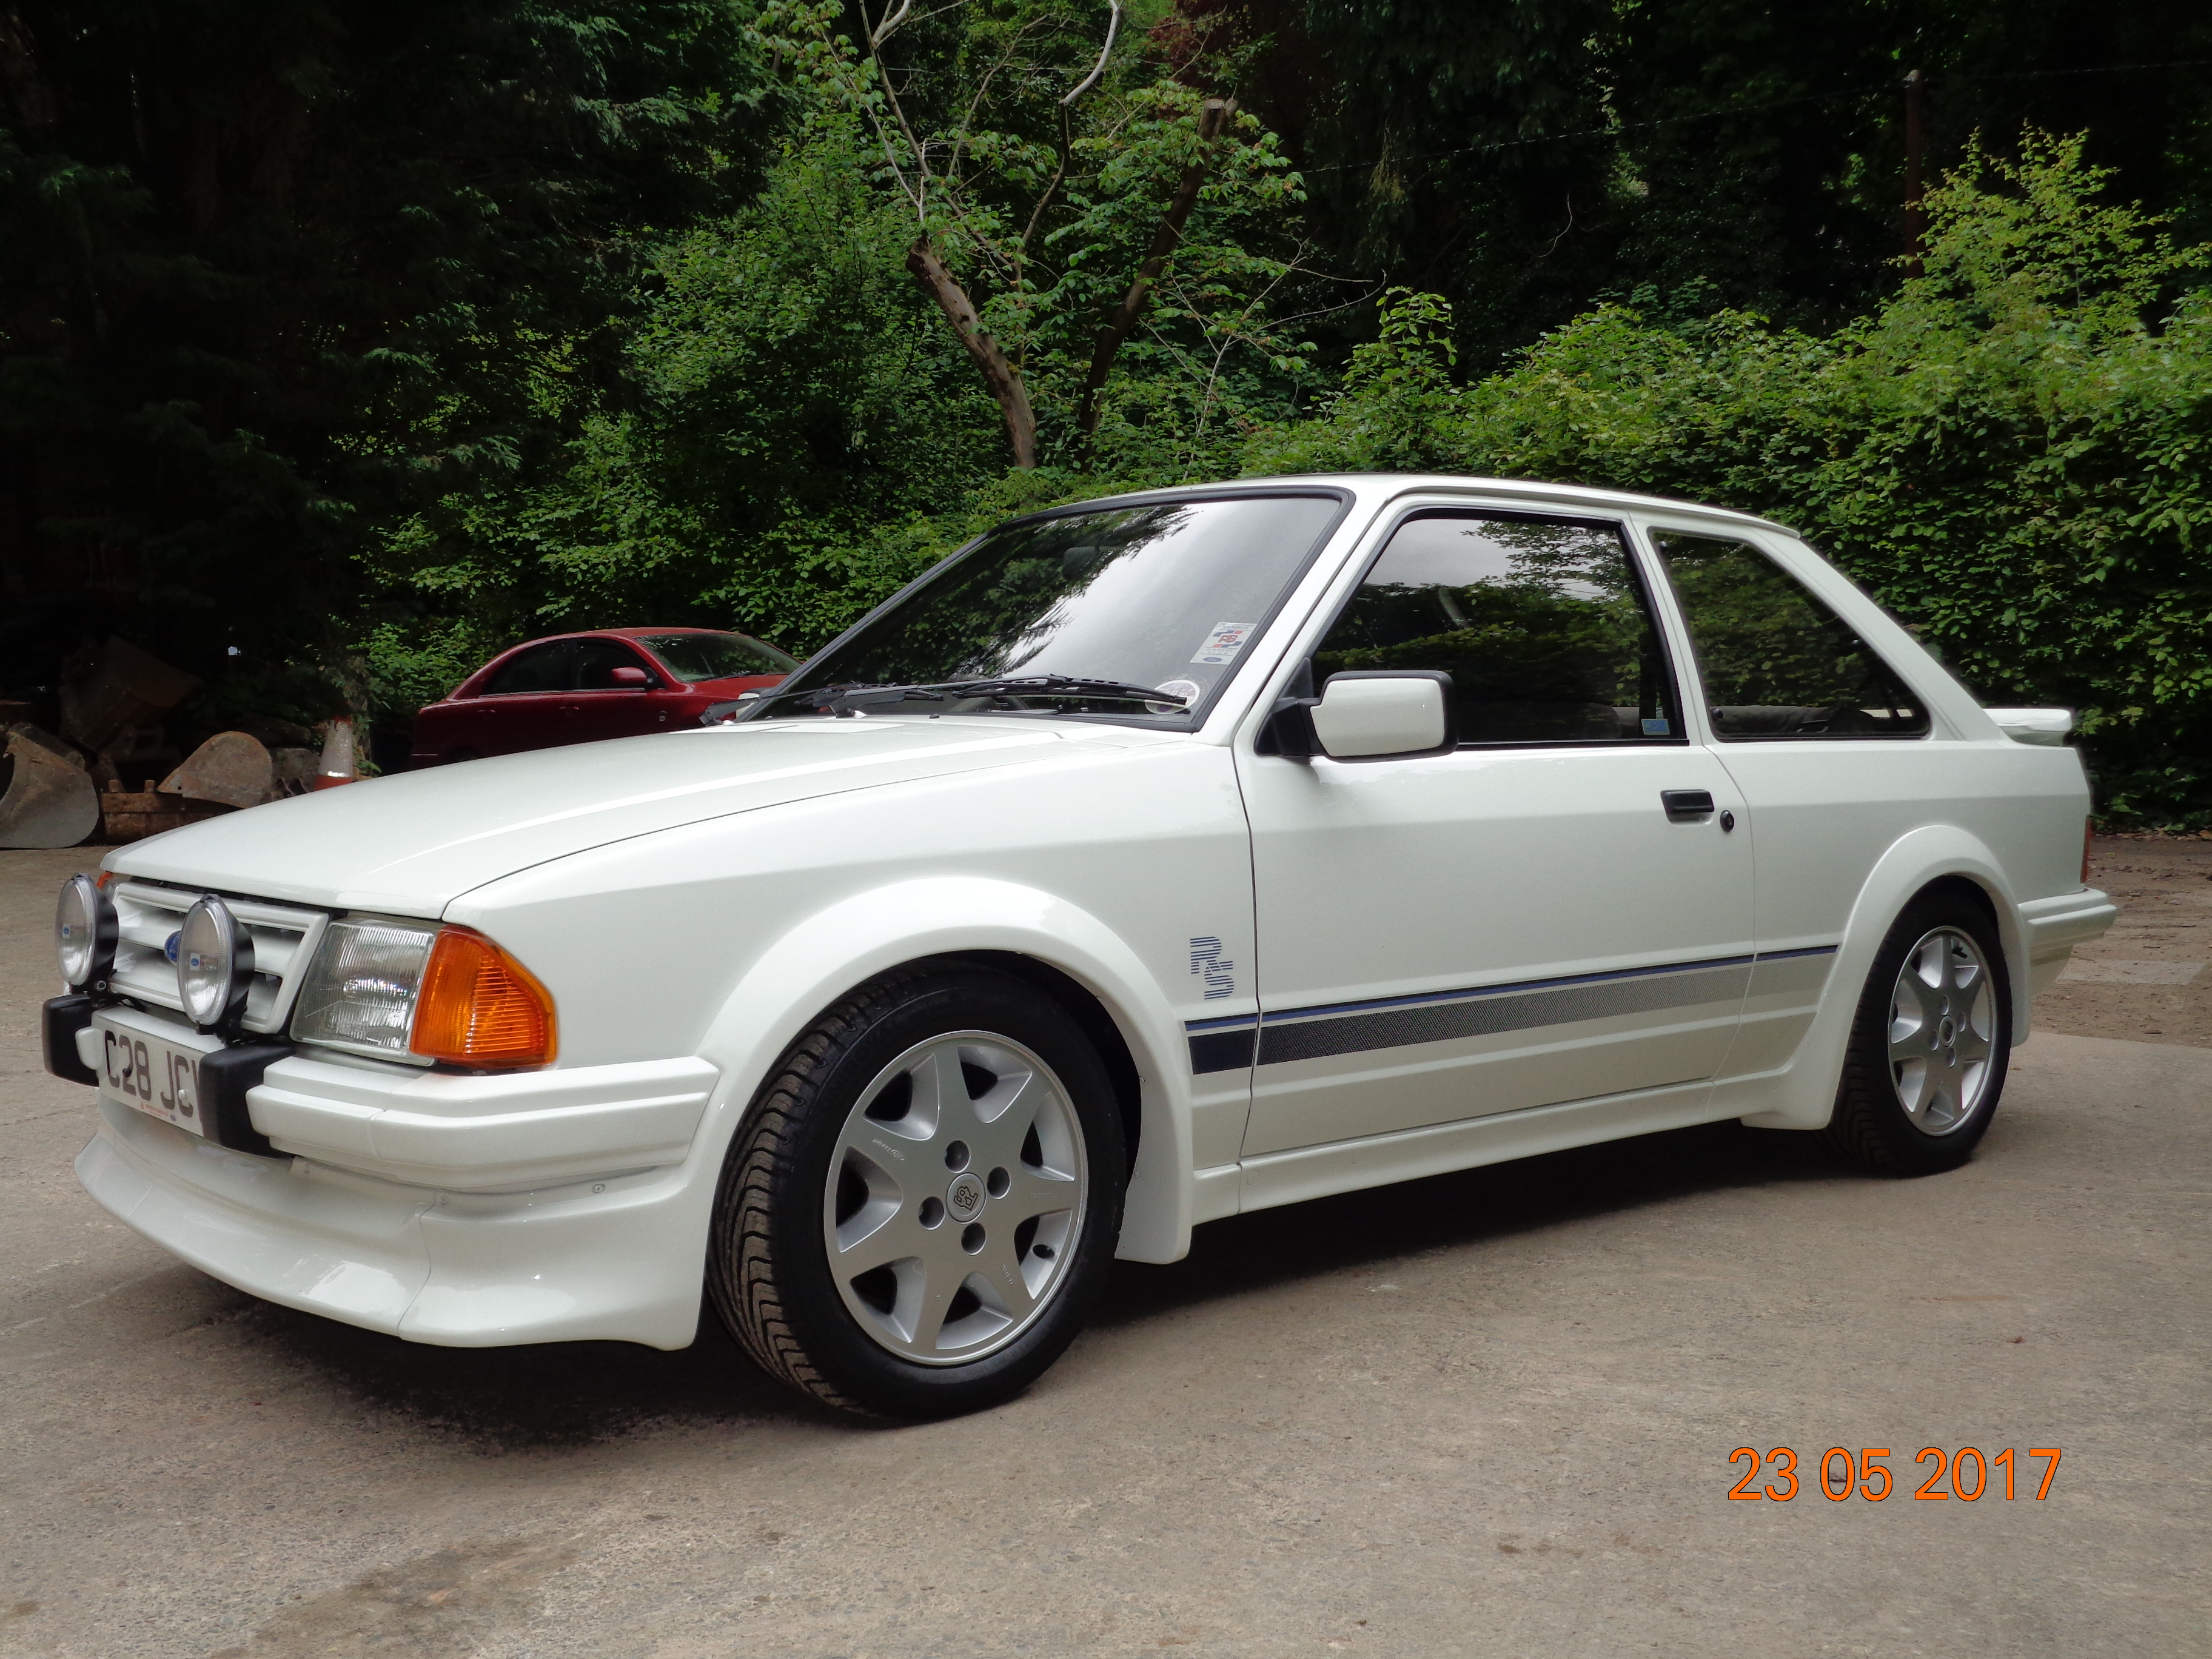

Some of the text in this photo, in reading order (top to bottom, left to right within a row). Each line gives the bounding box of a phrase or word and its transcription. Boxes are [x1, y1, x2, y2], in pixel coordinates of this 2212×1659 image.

[1218, 634, 1238, 643] RS
[1190, 936, 1235, 1000] RS
[104, 1030, 152, 1102] C28
